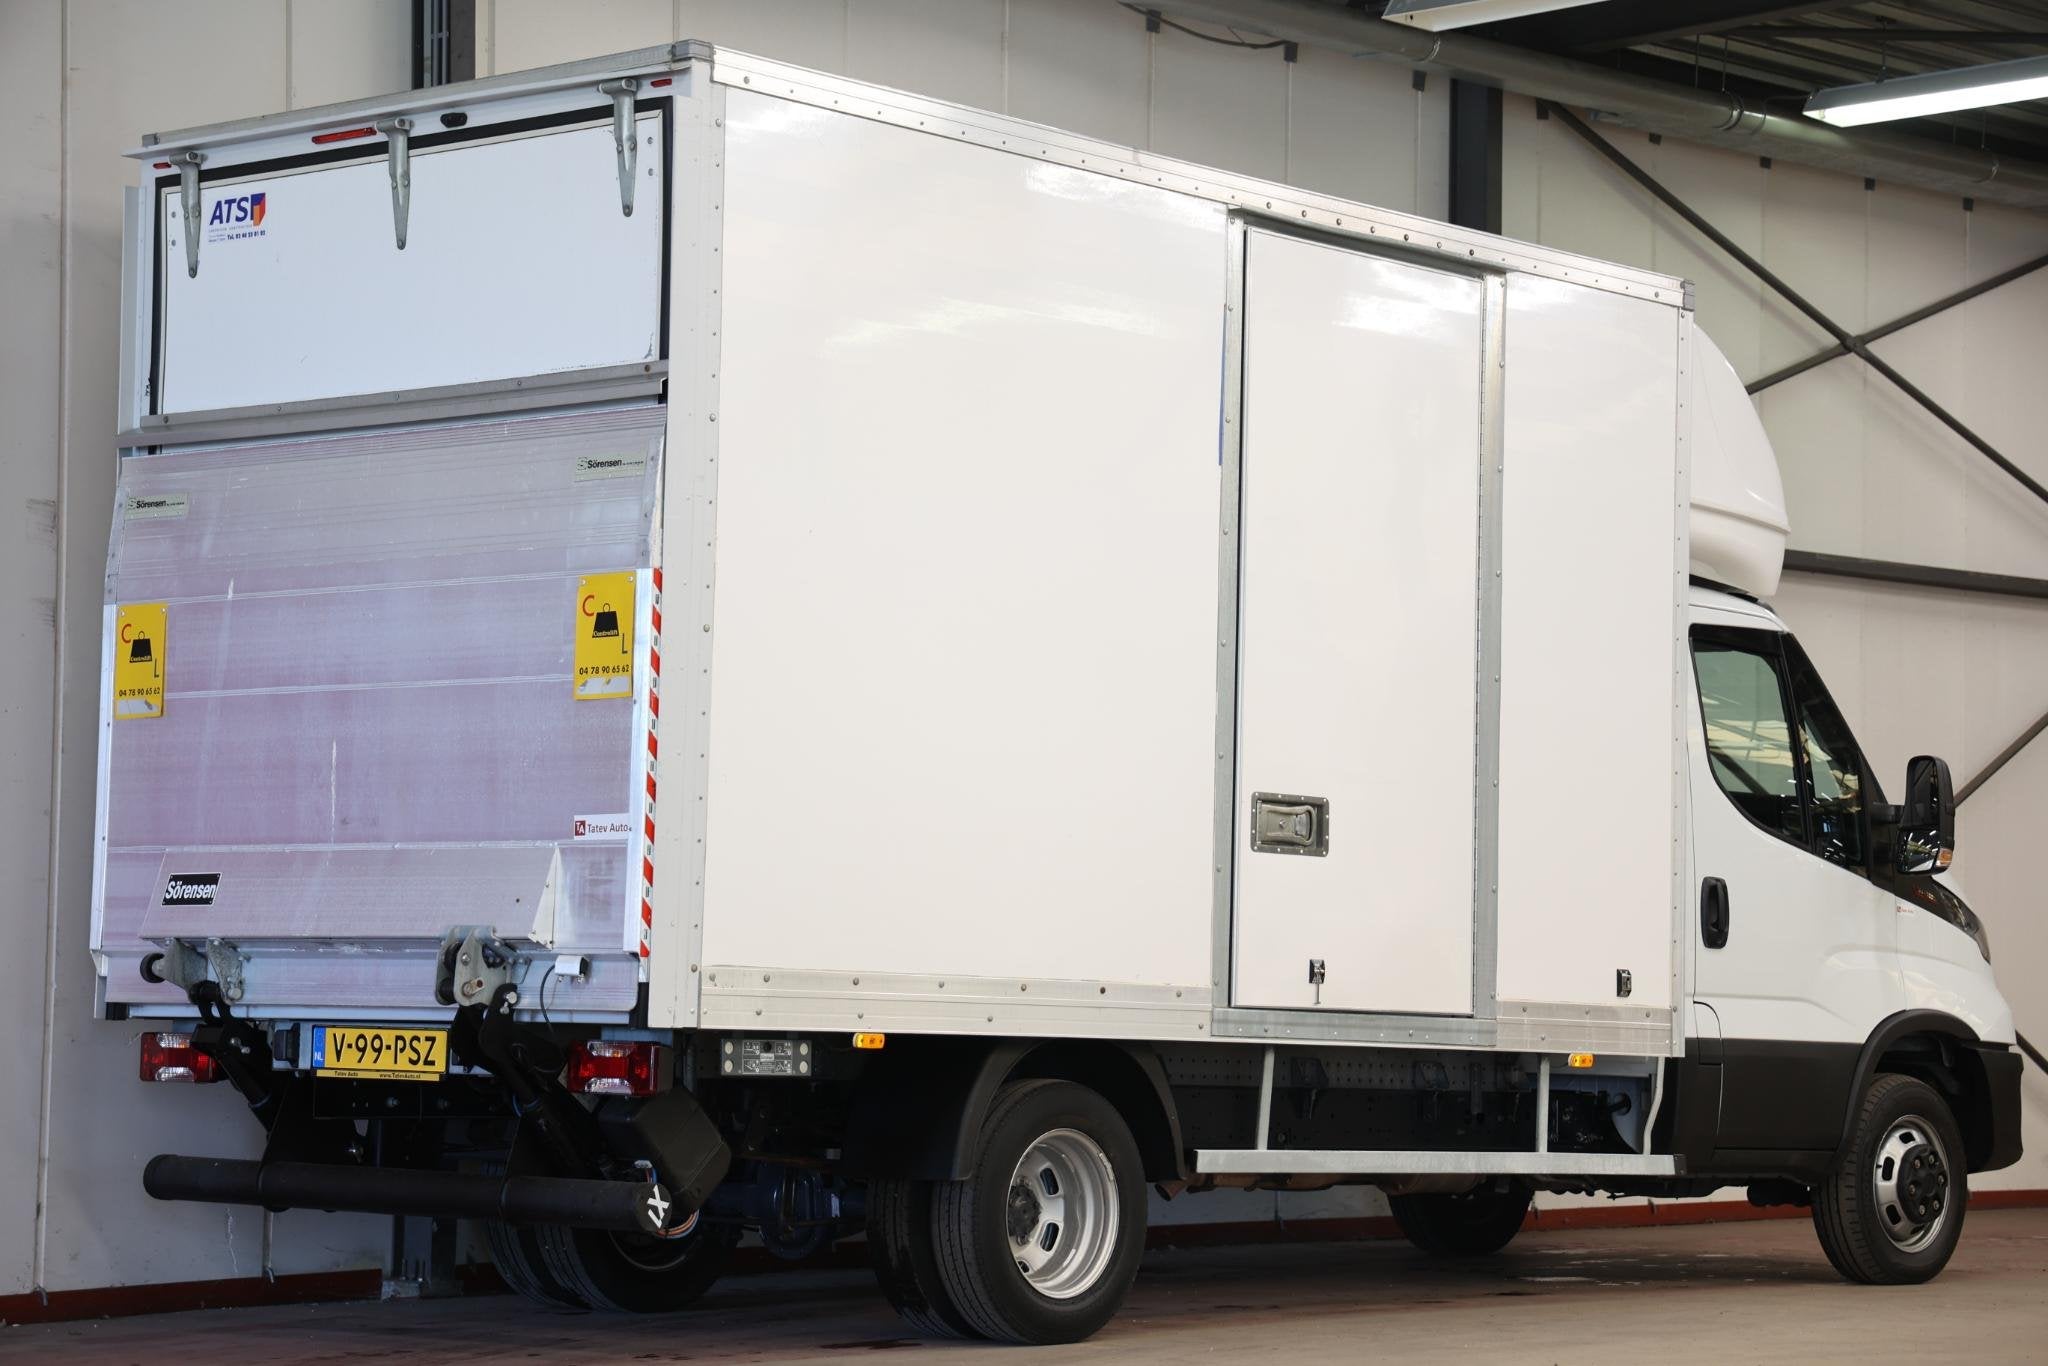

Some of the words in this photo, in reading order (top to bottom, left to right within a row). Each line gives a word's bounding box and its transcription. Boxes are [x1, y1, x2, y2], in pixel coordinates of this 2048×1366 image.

[209, 196, 249, 226] ATS
[587, 459, 622, 469] Sörensen
[136, 500, 167, 509] Sörensen
[582, 594, 595, 617] C
[621, 633, 628, 654] L
[154, 657, 160, 678] L
[579, 666, 588, 675] 04
[590, 666, 600, 675] 78
[601, 665, 610, 674] 90
[612, 665, 620, 673] 65
[621, 664, 629, 673] 62
[588, 823, 608, 833] Tatev
[165, 880, 217, 899] Sörensen
[314, 1051, 325, 1061] NL
[332, 1032, 437, 1066] V-99-PSZ
